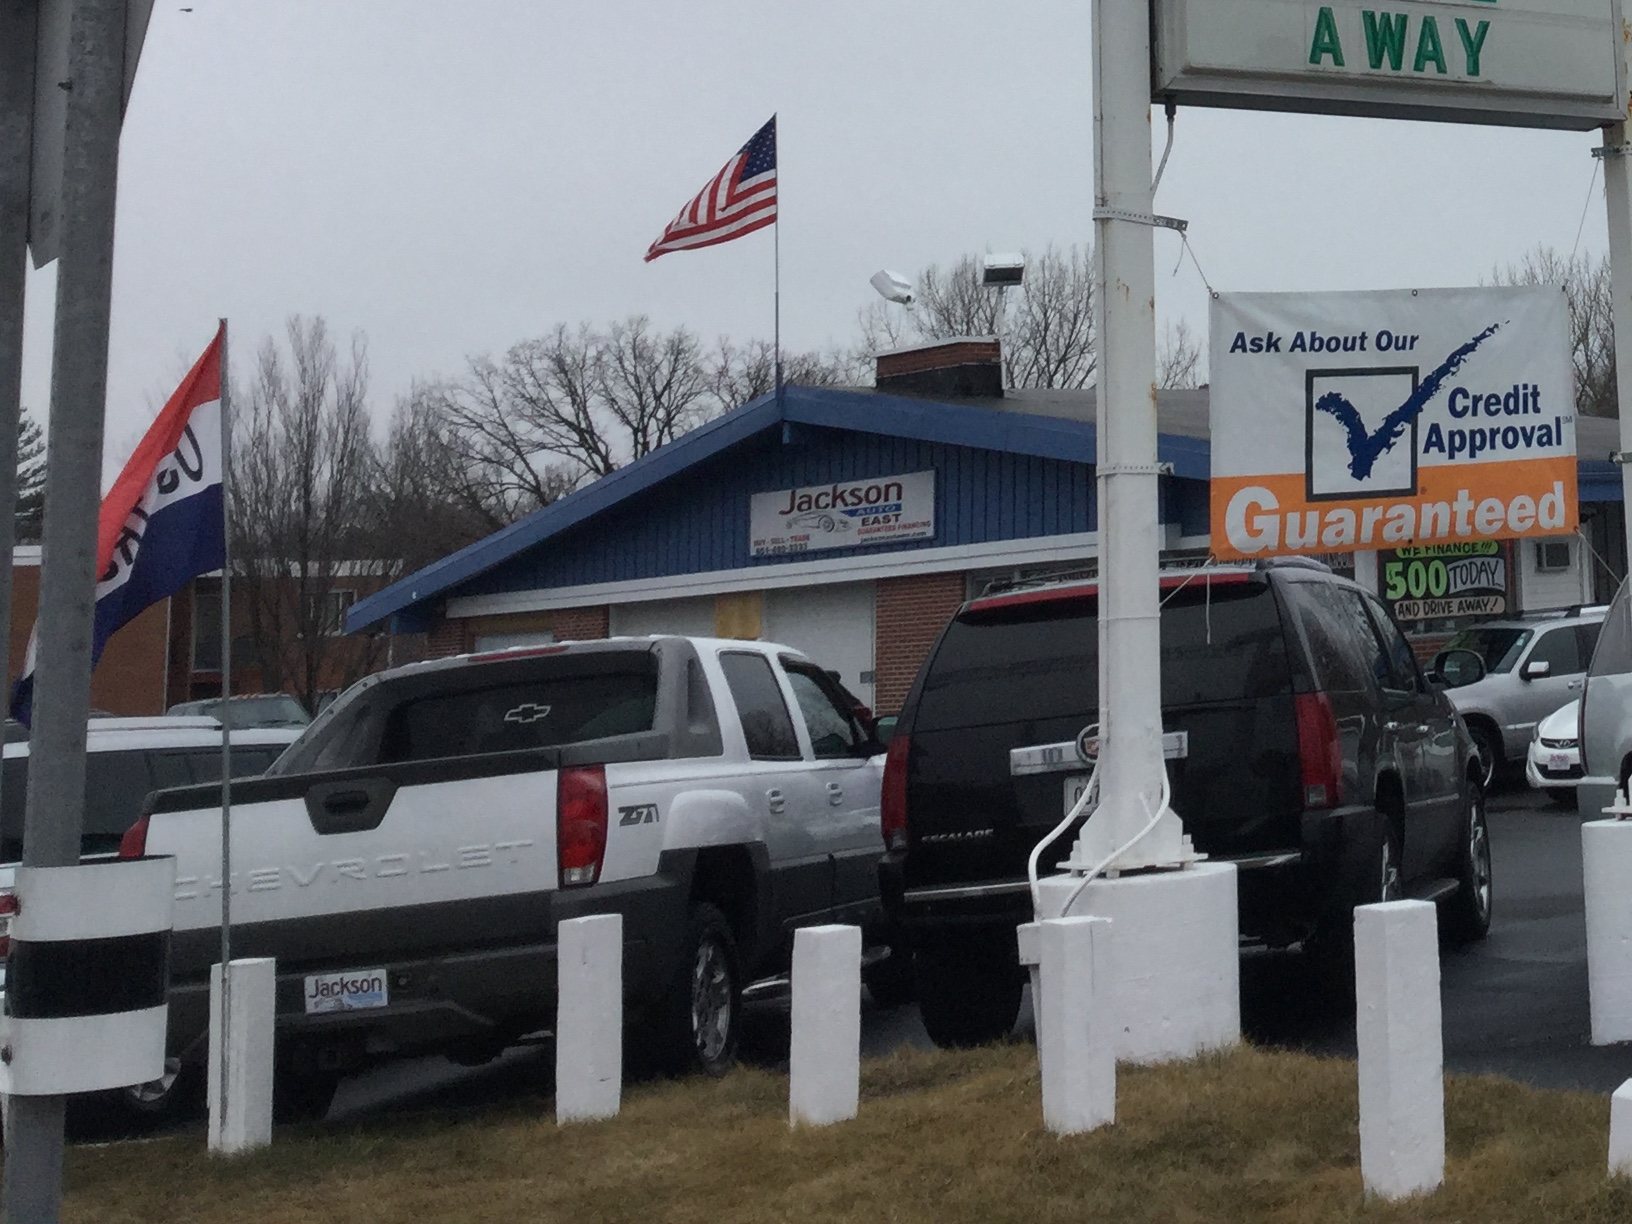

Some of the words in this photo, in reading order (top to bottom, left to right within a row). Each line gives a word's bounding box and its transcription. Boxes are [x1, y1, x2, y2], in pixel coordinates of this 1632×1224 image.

[1229, 331, 1282, 354] Ask
[1289, 330, 1368, 353] About
[1375, 329, 1419, 351] Our
[1447, 383, 1542, 419] Credit
[1422, 416, 1563, 460] Approval
[778, 482, 903, 515] Jackson
[856, 505, 896, 516] AUTO
[861, 513, 902, 527] EAST
[1225, 481, 1566, 554] Guaranteed
[1401, 545, 1420, 556] WE
[1448, 559, 1504, 589] TODAY
[1398, 602, 1420, 617] AND
[1423, 601, 1454, 615] DRIVE
[1457, 597, 1498, 614] AWAY!
[173, 840, 533, 901] CHEVROLET
[308, 974, 383, 999] Jackson
